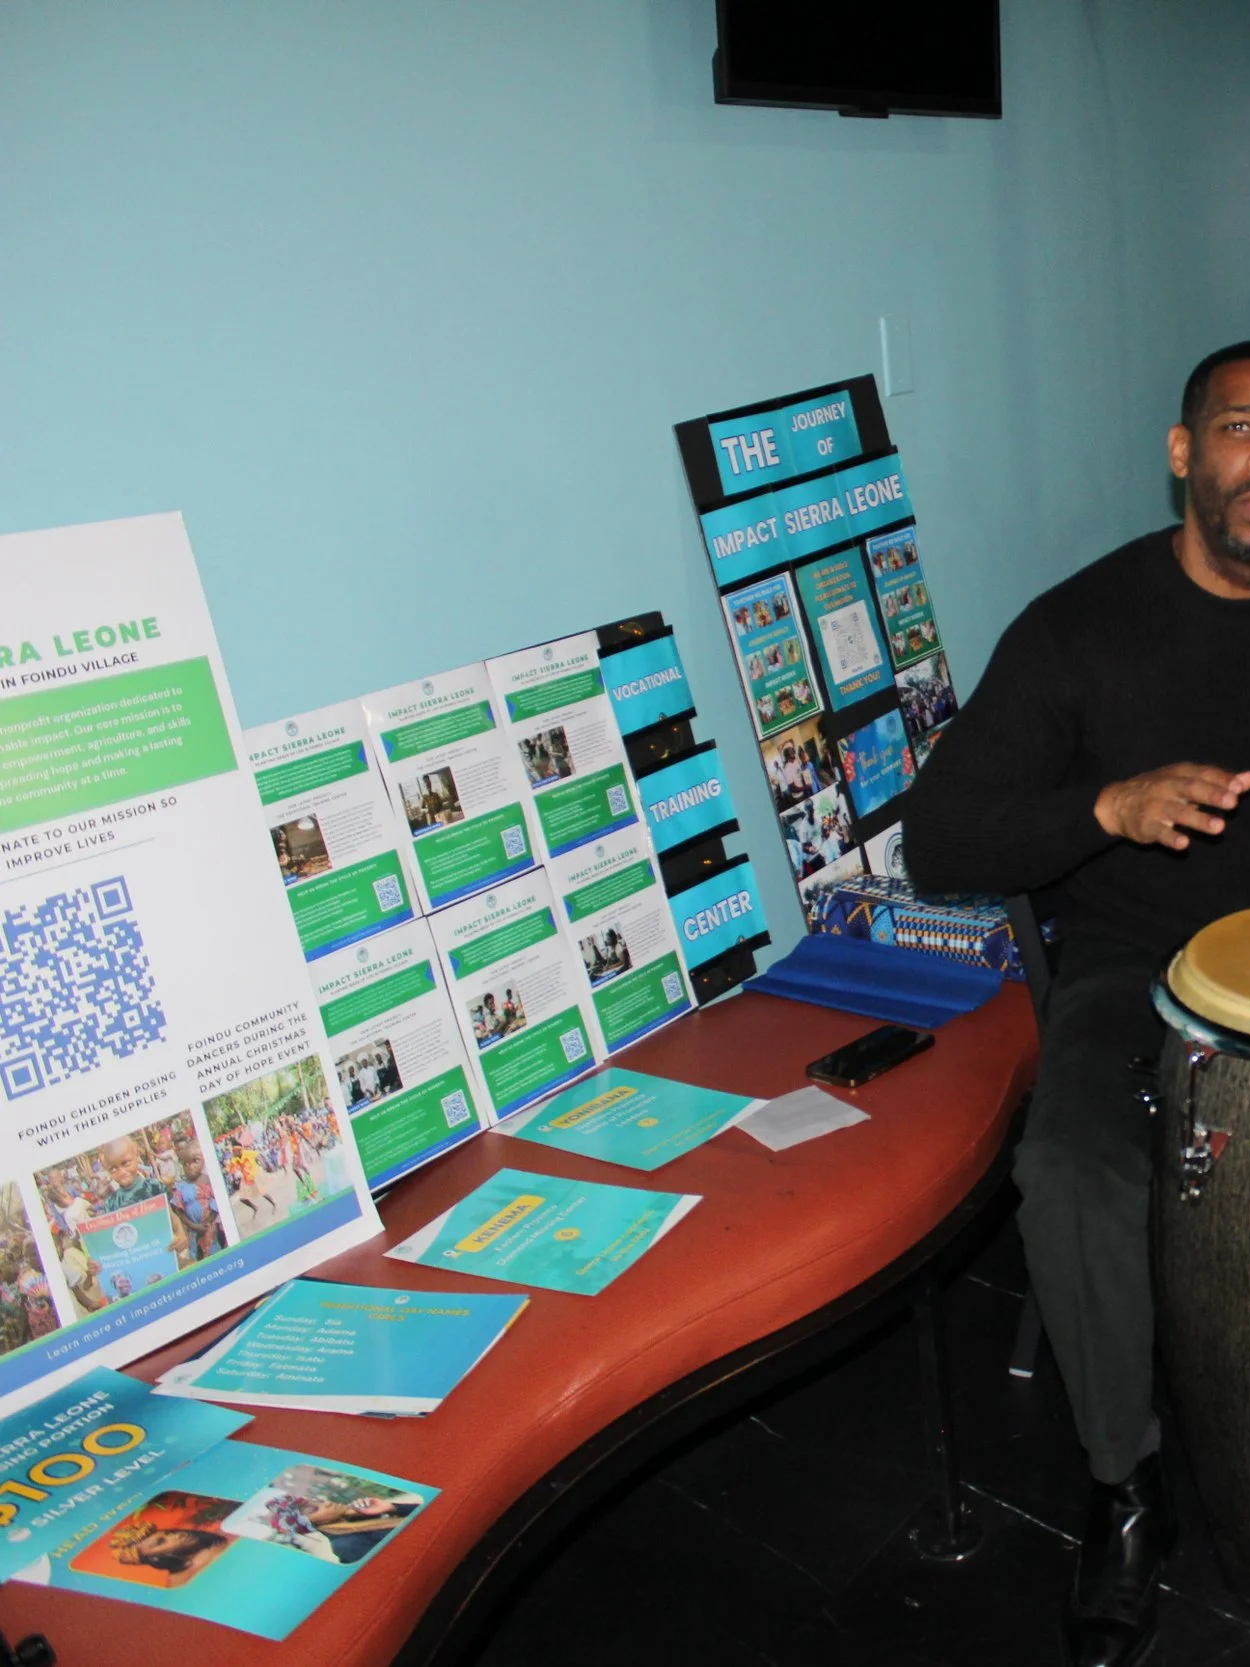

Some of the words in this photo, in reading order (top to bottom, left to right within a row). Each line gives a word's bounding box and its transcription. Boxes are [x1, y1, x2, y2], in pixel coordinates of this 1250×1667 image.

[791, 402, 846, 432] JOURNEY
[720, 428, 780, 475] THE
[817, 437, 833, 456] OF
[713, 516, 778, 559] IMPACT
[784, 498, 844, 535] SIERRA
[845, 474, 903, 515] LEONE
[53, 616, 161, 657] LEONE
[1, 674, 17, 689] IN
[21, 664, 77, 685] FOINDU
[81, 651, 139, 672] VILLAGE
[512, 669, 537, 682] IMPACT
[539, 662, 565, 673] SIERRA
[567, 655, 589, 666] LEONE
[613, 666, 682, 701] VOCATIONAL
[53, 701, 118, 723] organization
[119, 690, 170, 709] dedicated
[171, 687, 183, 696] to
[74, 724, 94, 735] Our
[97, 717, 119, 730] core
[121, 707, 160, 724] mission
[161, 706, 170, 716] is
[171, 703, 183, 712] to
[388, 704, 417, 719] IMPACT
[420, 696, 448, 708] SIERRA
[450, 687, 475, 699] LEONE
[147, 723, 165, 734] and
[167, 717, 192, 730] skills
[282, 736, 314, 751] SIERRA
[317, 726, 346, 741] LEONE
[51, 762, 79, 777] hope
[81, 756, 101, 768] and
[103, 746, 141, 762] making
[149, 735, 183, 751] lasting
[15, 779, 78, 800] community
[81, 775, 91, 785] at
[650, 777, 721, 823] TRAINING
[1, 834, 39, 853] NATE
[44, 828, 62, 841] TO
[67, 818, 97, 834] OUR
[101, 802, 156, 826] MISSION
[160, 796, 178, 808] SO
[6, 842, 73, 870] IMPROVE
[76, 830, 115, 849] LIVES
[568, 867, 592, 883] IMPACT
[594, 857, 616, 871] SIERRA
[617, 847, 638, 860] LEONE
[454, 918, 482, 937] IMPACT
[484, 907, 511, 923] SIERRA
[512, 895, 536, 910] LEONE
[683, 890, 752, 942] CENTER
[319, 973, 351, 994] IMPACT
[353, 960, 385, 978] SIERRA
[386, 948, 414, 964] LEONE
[186, 1040, 240, 1068] DANCERS
[243, 1022, 285, 1045] DURING
[288, 1012, 308, 1026] THE
[188, 1028, 232, 1052] FOINDU
[235, 1001, 299, 1033] COMMUNITY
[197, 1055, 243, 1080] ANNUAL
[246, 1028, 306, 1059] CHRISTMAS
[199, 1077, 222, 1094] DAY
[226, 1070, 241, 1082] OF
[244, 1056, 275, 1074] HOPE
[277, 1040, 310, 1060] EVENT
[18, 1114, 66, 1141] FOINDU
[70, 1089, 131, 1118] CHILDREN
[134, 1071, 177, 1094] POSING
[36, 1128, 70, 1148] WITH
[74, 1113, 110, 1133] THEIR
[113, 1089, 168, 1117] SUPPLIES
[473, 1204, 530, 1242] KENEMA
[46, 1340, 80, 1361] Learn
[83, 1325, 112, 1342] more
[115, 1315, 127, 1328] at
[130, 1257, 245, 1320] impactsierraleone.org
[274, 1314, 317, 1326] Sunday:
[38, 1403, 114, 1448] PORTION
[44, 1390, 110, 1430] LEONE
[31, 1484, 104, 1527] SILVER
[103, 1449, 166, 1485] LEVEL
